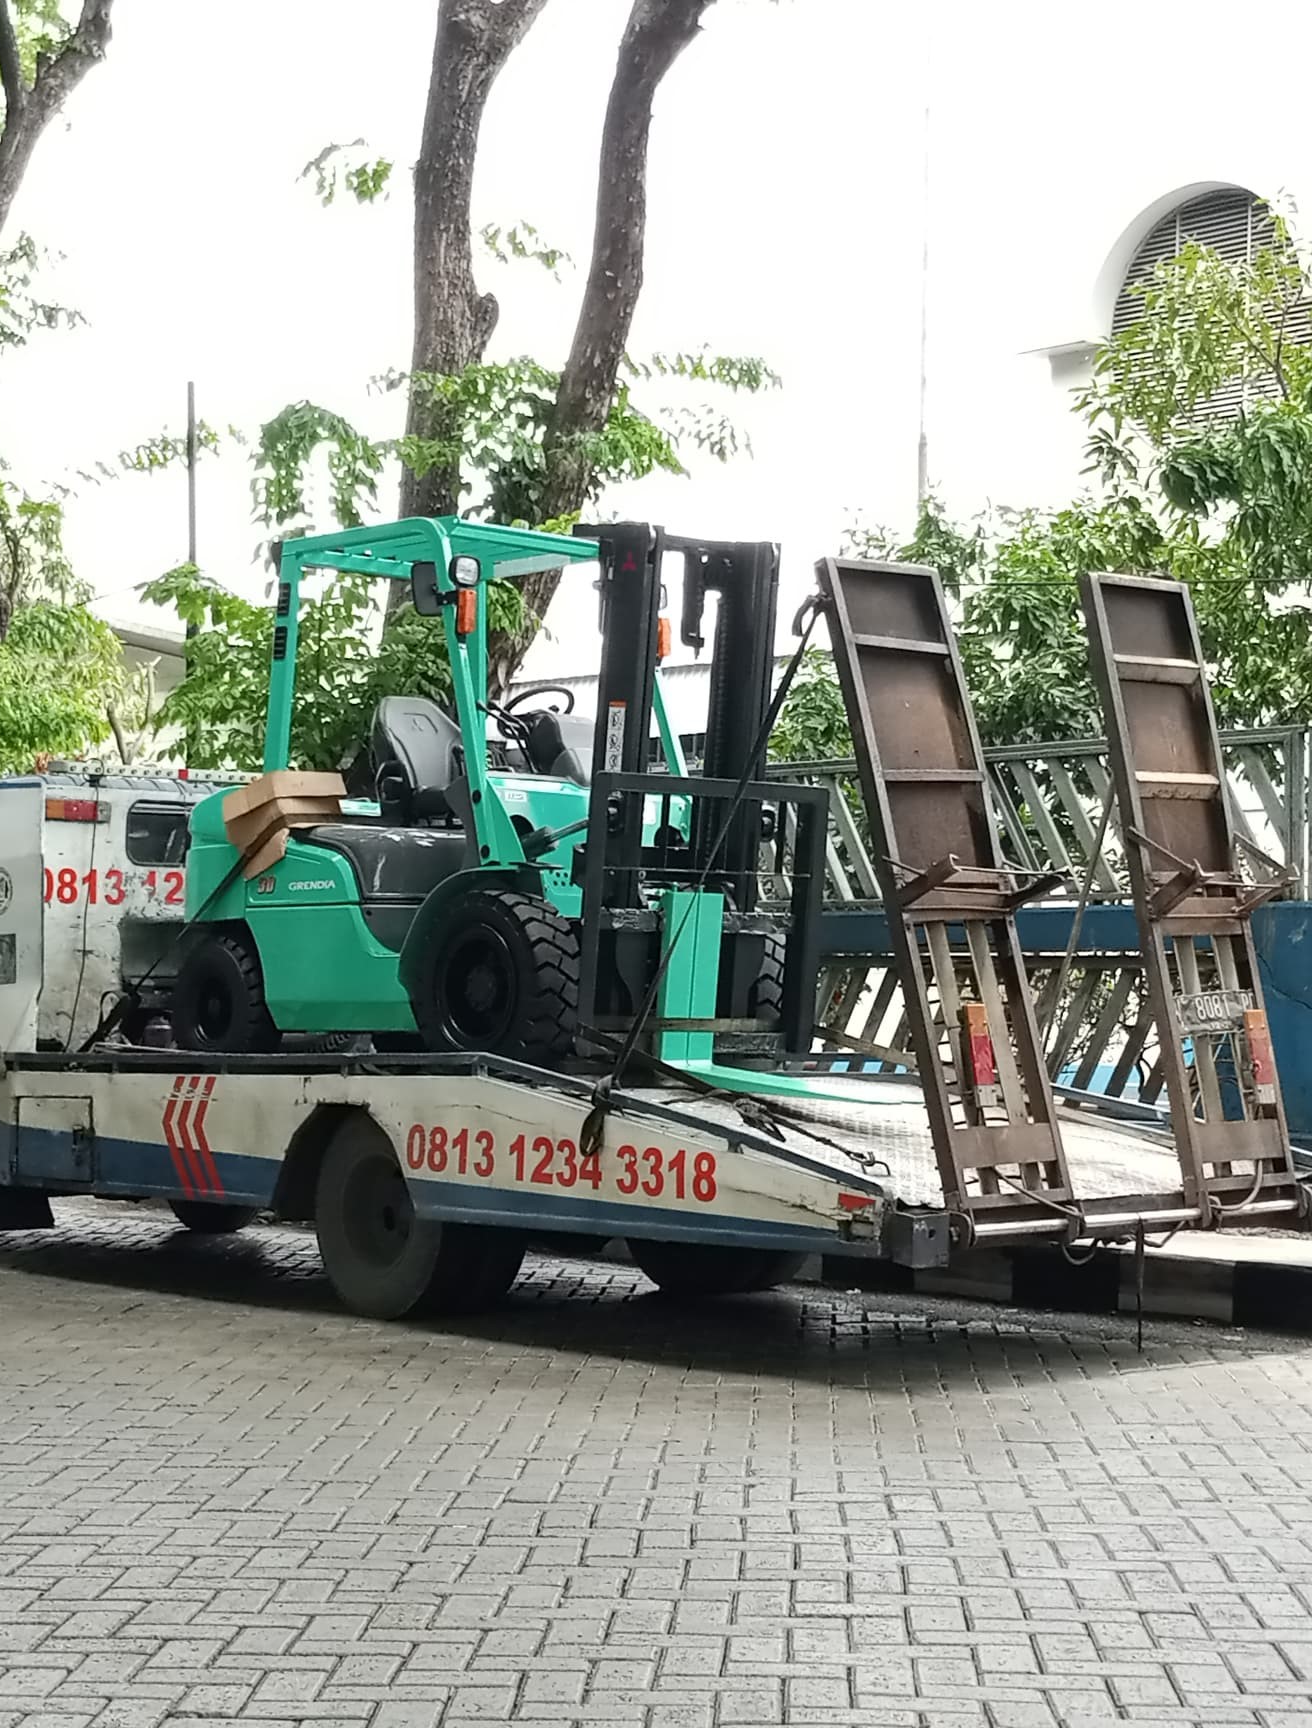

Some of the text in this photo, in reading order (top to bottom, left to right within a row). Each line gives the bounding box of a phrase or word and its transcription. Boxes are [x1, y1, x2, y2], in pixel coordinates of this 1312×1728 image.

[288, 880, 336, 891] GRENDIA
[1195, 993, 1231, 1020] 8081
[407, 1124, 716, 1202] 0813 1234 3318
